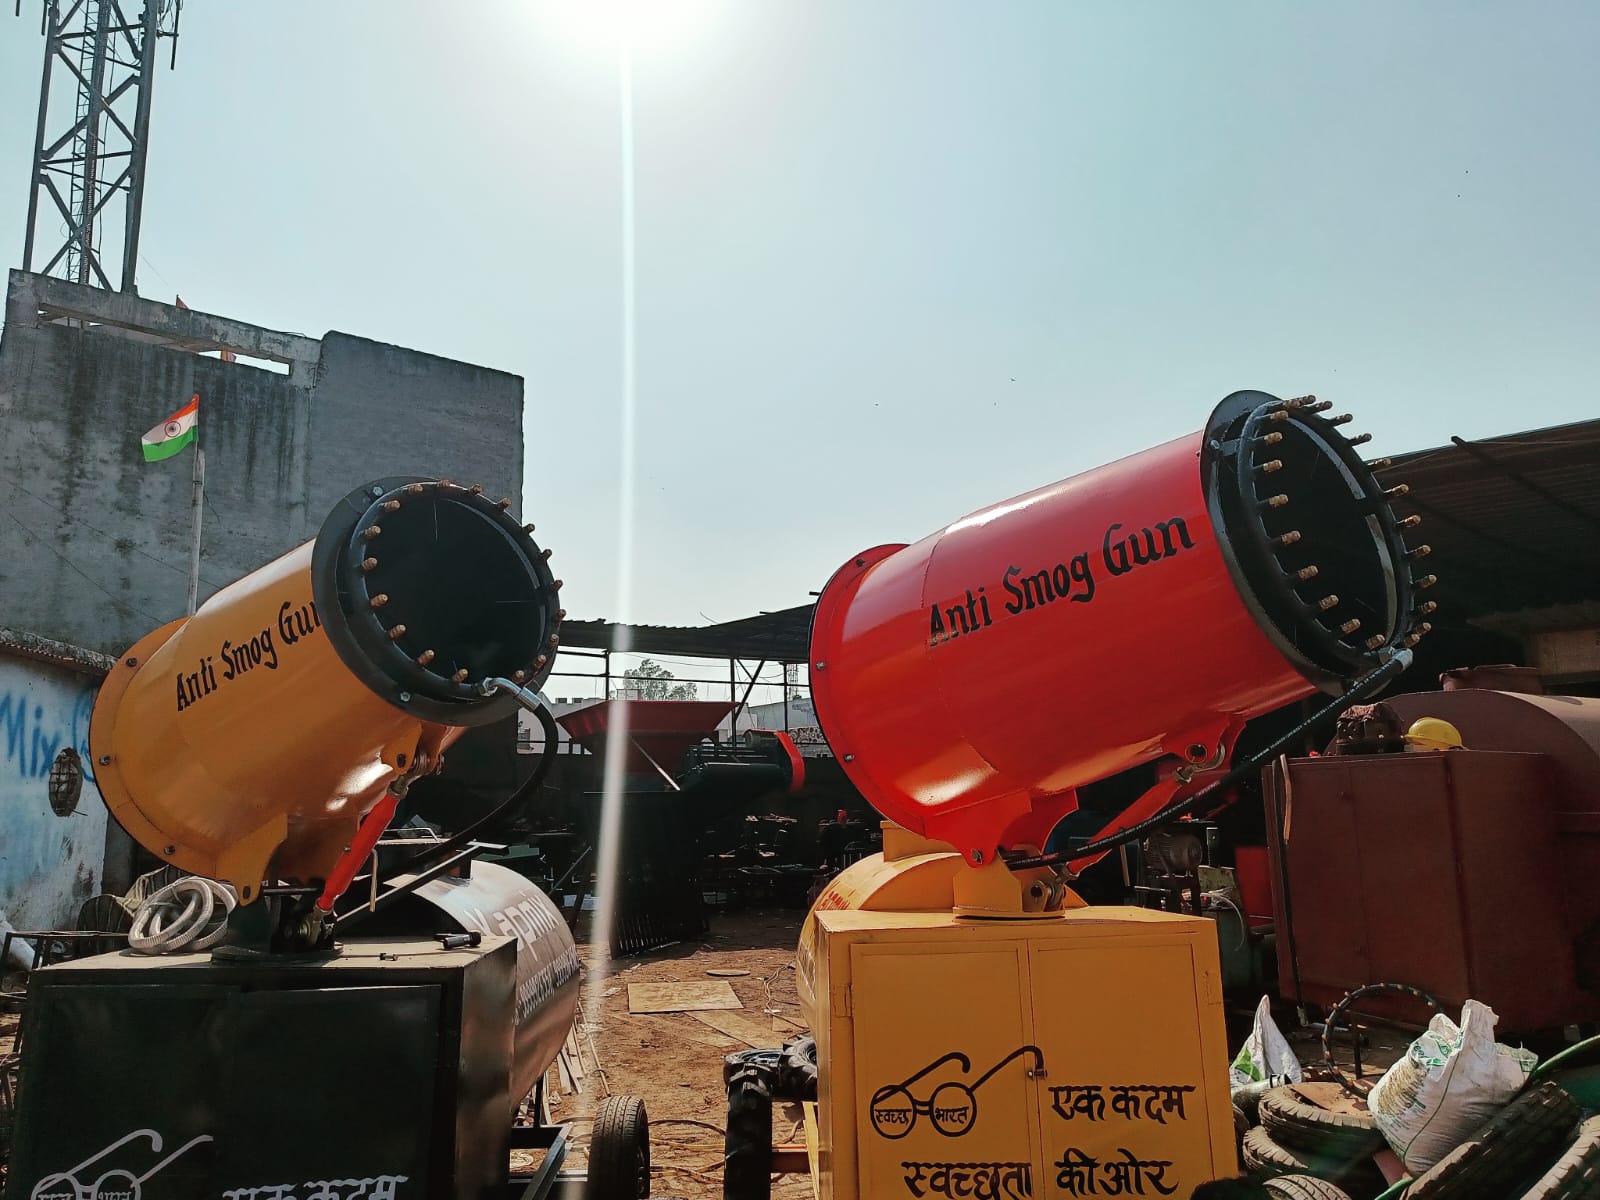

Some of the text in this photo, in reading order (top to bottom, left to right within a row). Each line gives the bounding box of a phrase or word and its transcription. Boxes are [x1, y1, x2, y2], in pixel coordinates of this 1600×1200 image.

[929, 516, 1197, 647] Anti Smog Gun
[175, 656, 218, 712] Anti
[220, 627, 278, 681] Smog
[935, 1106, 970, 1124] भारत
[1048, 1084, 1197, 1124] एक कदम
